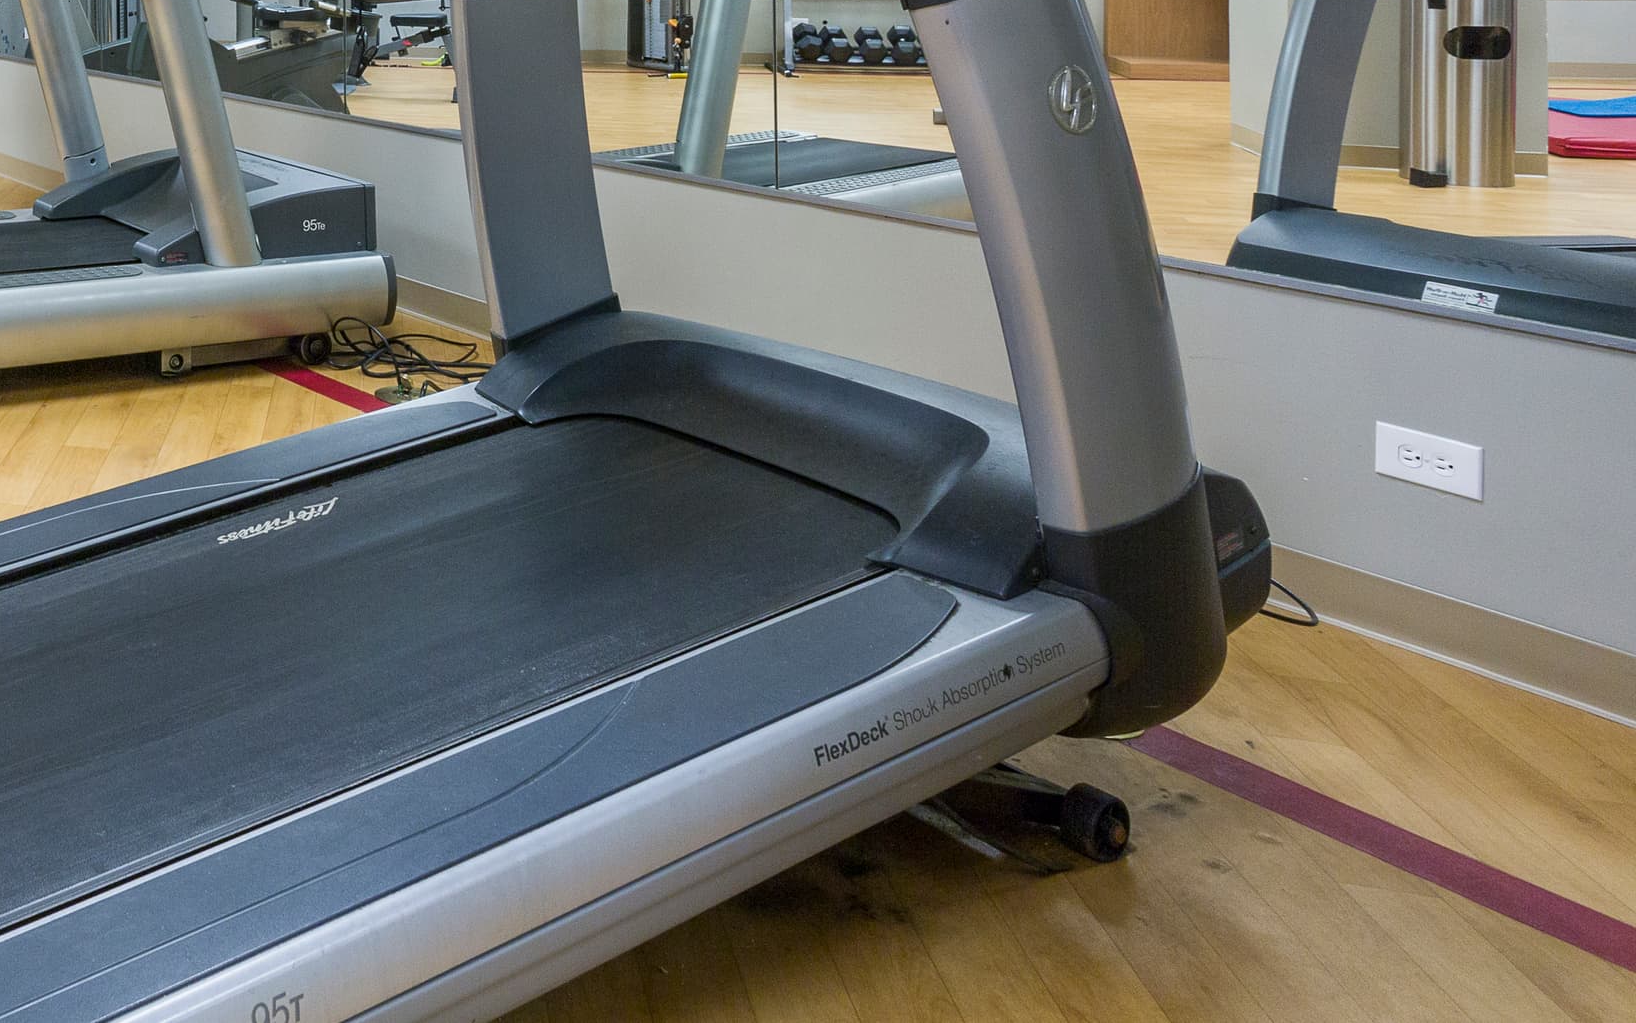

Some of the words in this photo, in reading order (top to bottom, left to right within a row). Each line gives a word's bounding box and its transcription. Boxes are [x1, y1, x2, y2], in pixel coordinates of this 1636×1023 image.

[812, 719, 890, 767] FlexDeck
[892, 697, 940, 731] Shock
[941, 663, 1016, 710] Absorption
[1015, 641, 1066, 676] System
